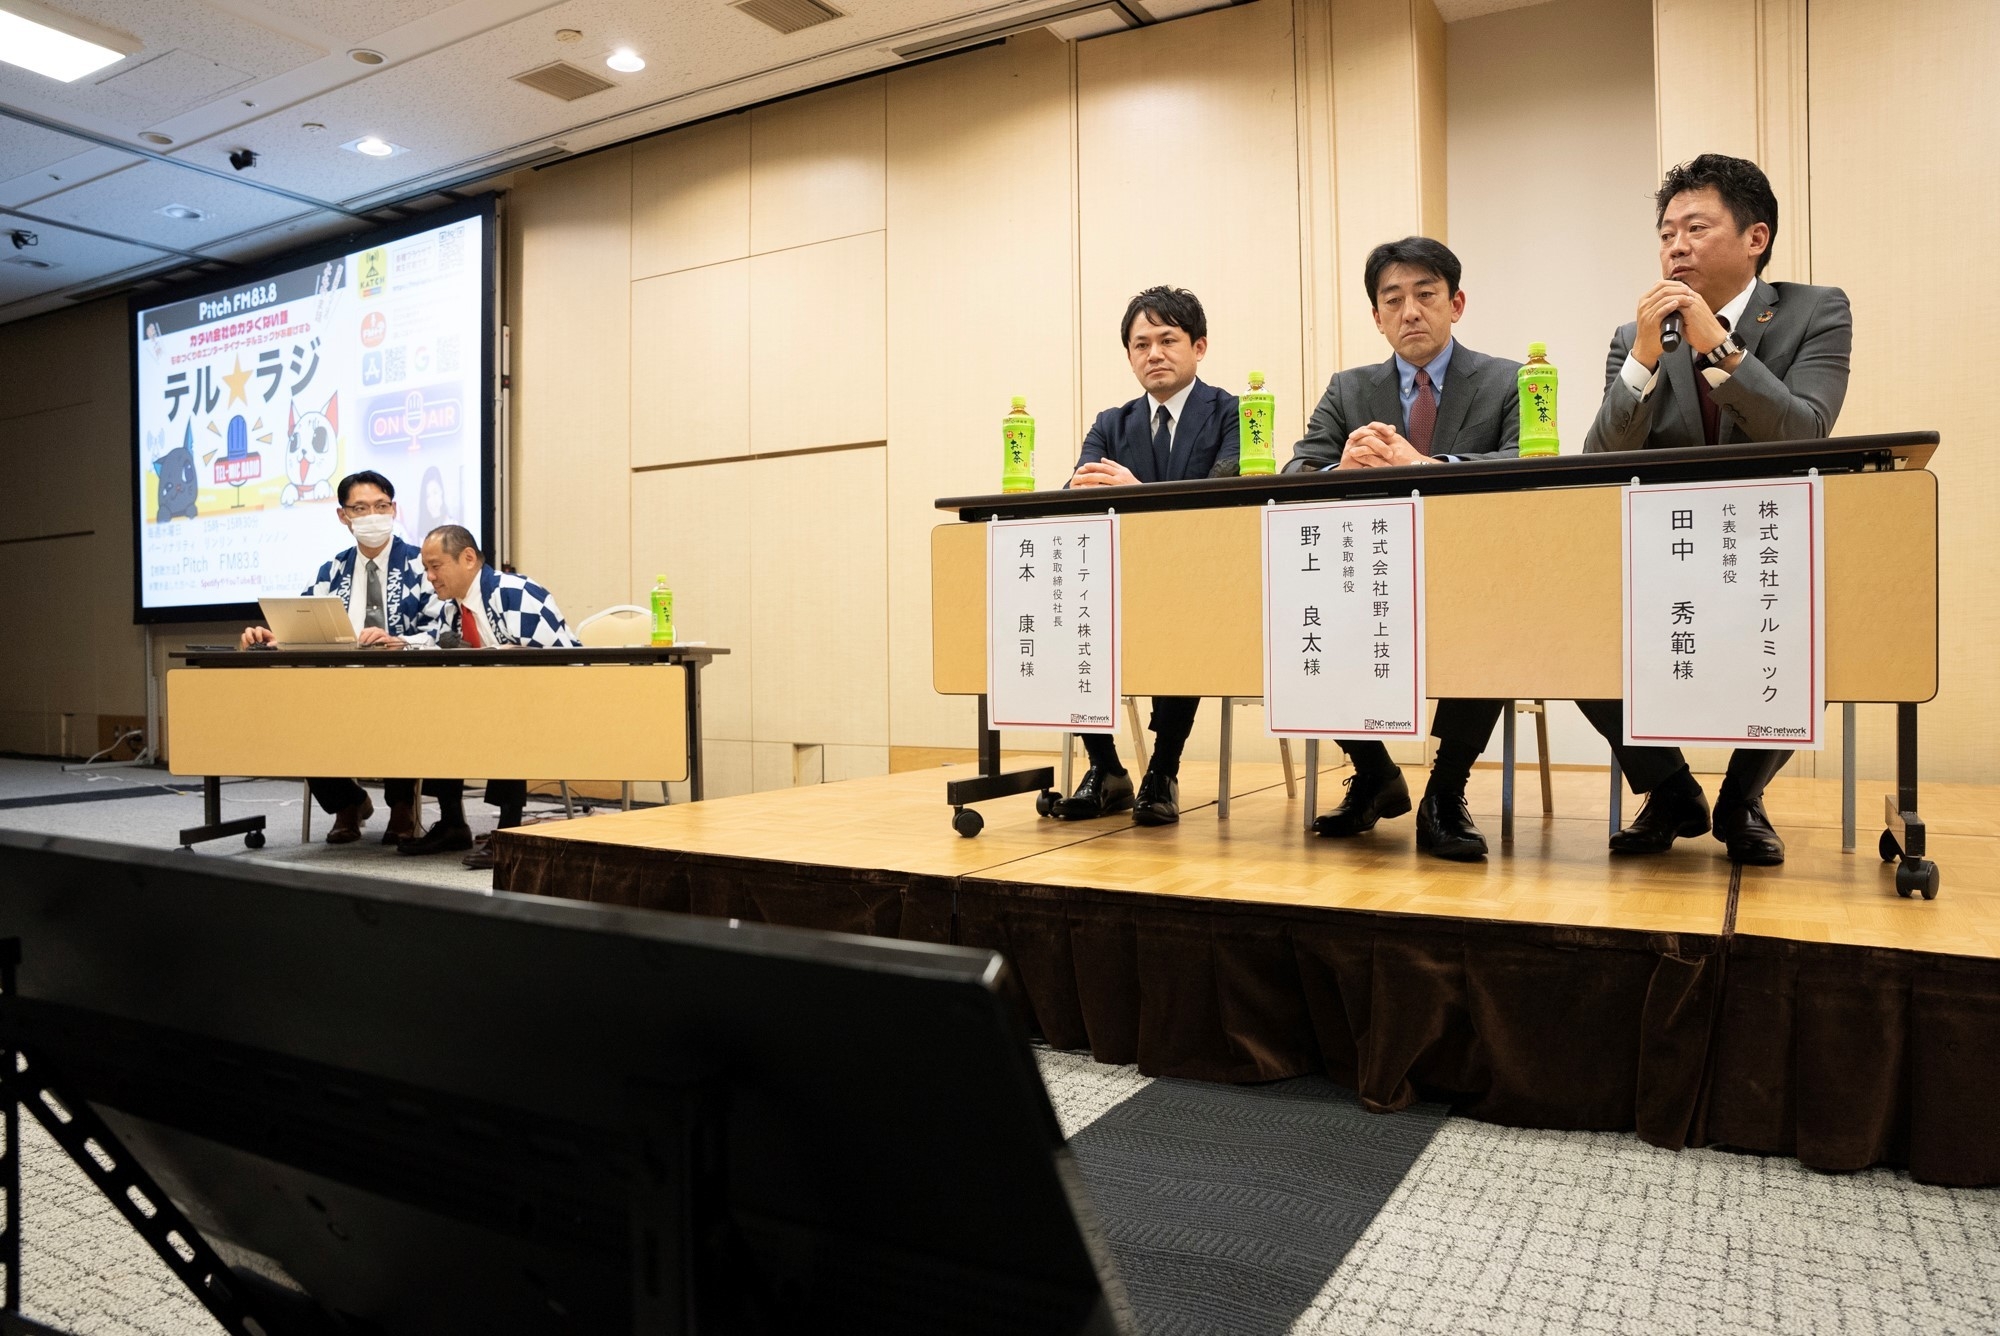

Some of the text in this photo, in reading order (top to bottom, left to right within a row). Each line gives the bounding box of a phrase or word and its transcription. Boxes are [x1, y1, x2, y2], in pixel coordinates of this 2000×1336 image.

[199, 282, 277, 320] Pitch FM83.8
[374, 406, 455, 437] ON AIR
[183, 557, 209, 573] Pitch
[220, 550, 260, 570] FM83.8
[1052, 535, 1063, 627] 代表取締役社長
[1342, 521, 1355, 593] 代表取締役
[1722, 503, 1737, 584] 代表取締役
[1018, 538, 1035, 677] 角本 康司様
[1077, 533, 1092, 693] オーティス株式会社
[1300, 525, 1322, 676] 野上 良太様
[1371, 518, 1390, 679] 株式会社野上技研
[1670, 509, 1696, 680] 田中 秀範様
[1758, 499, 1780, 703] 株式会社テルミック
[1773, 726, 1806, 734] network
